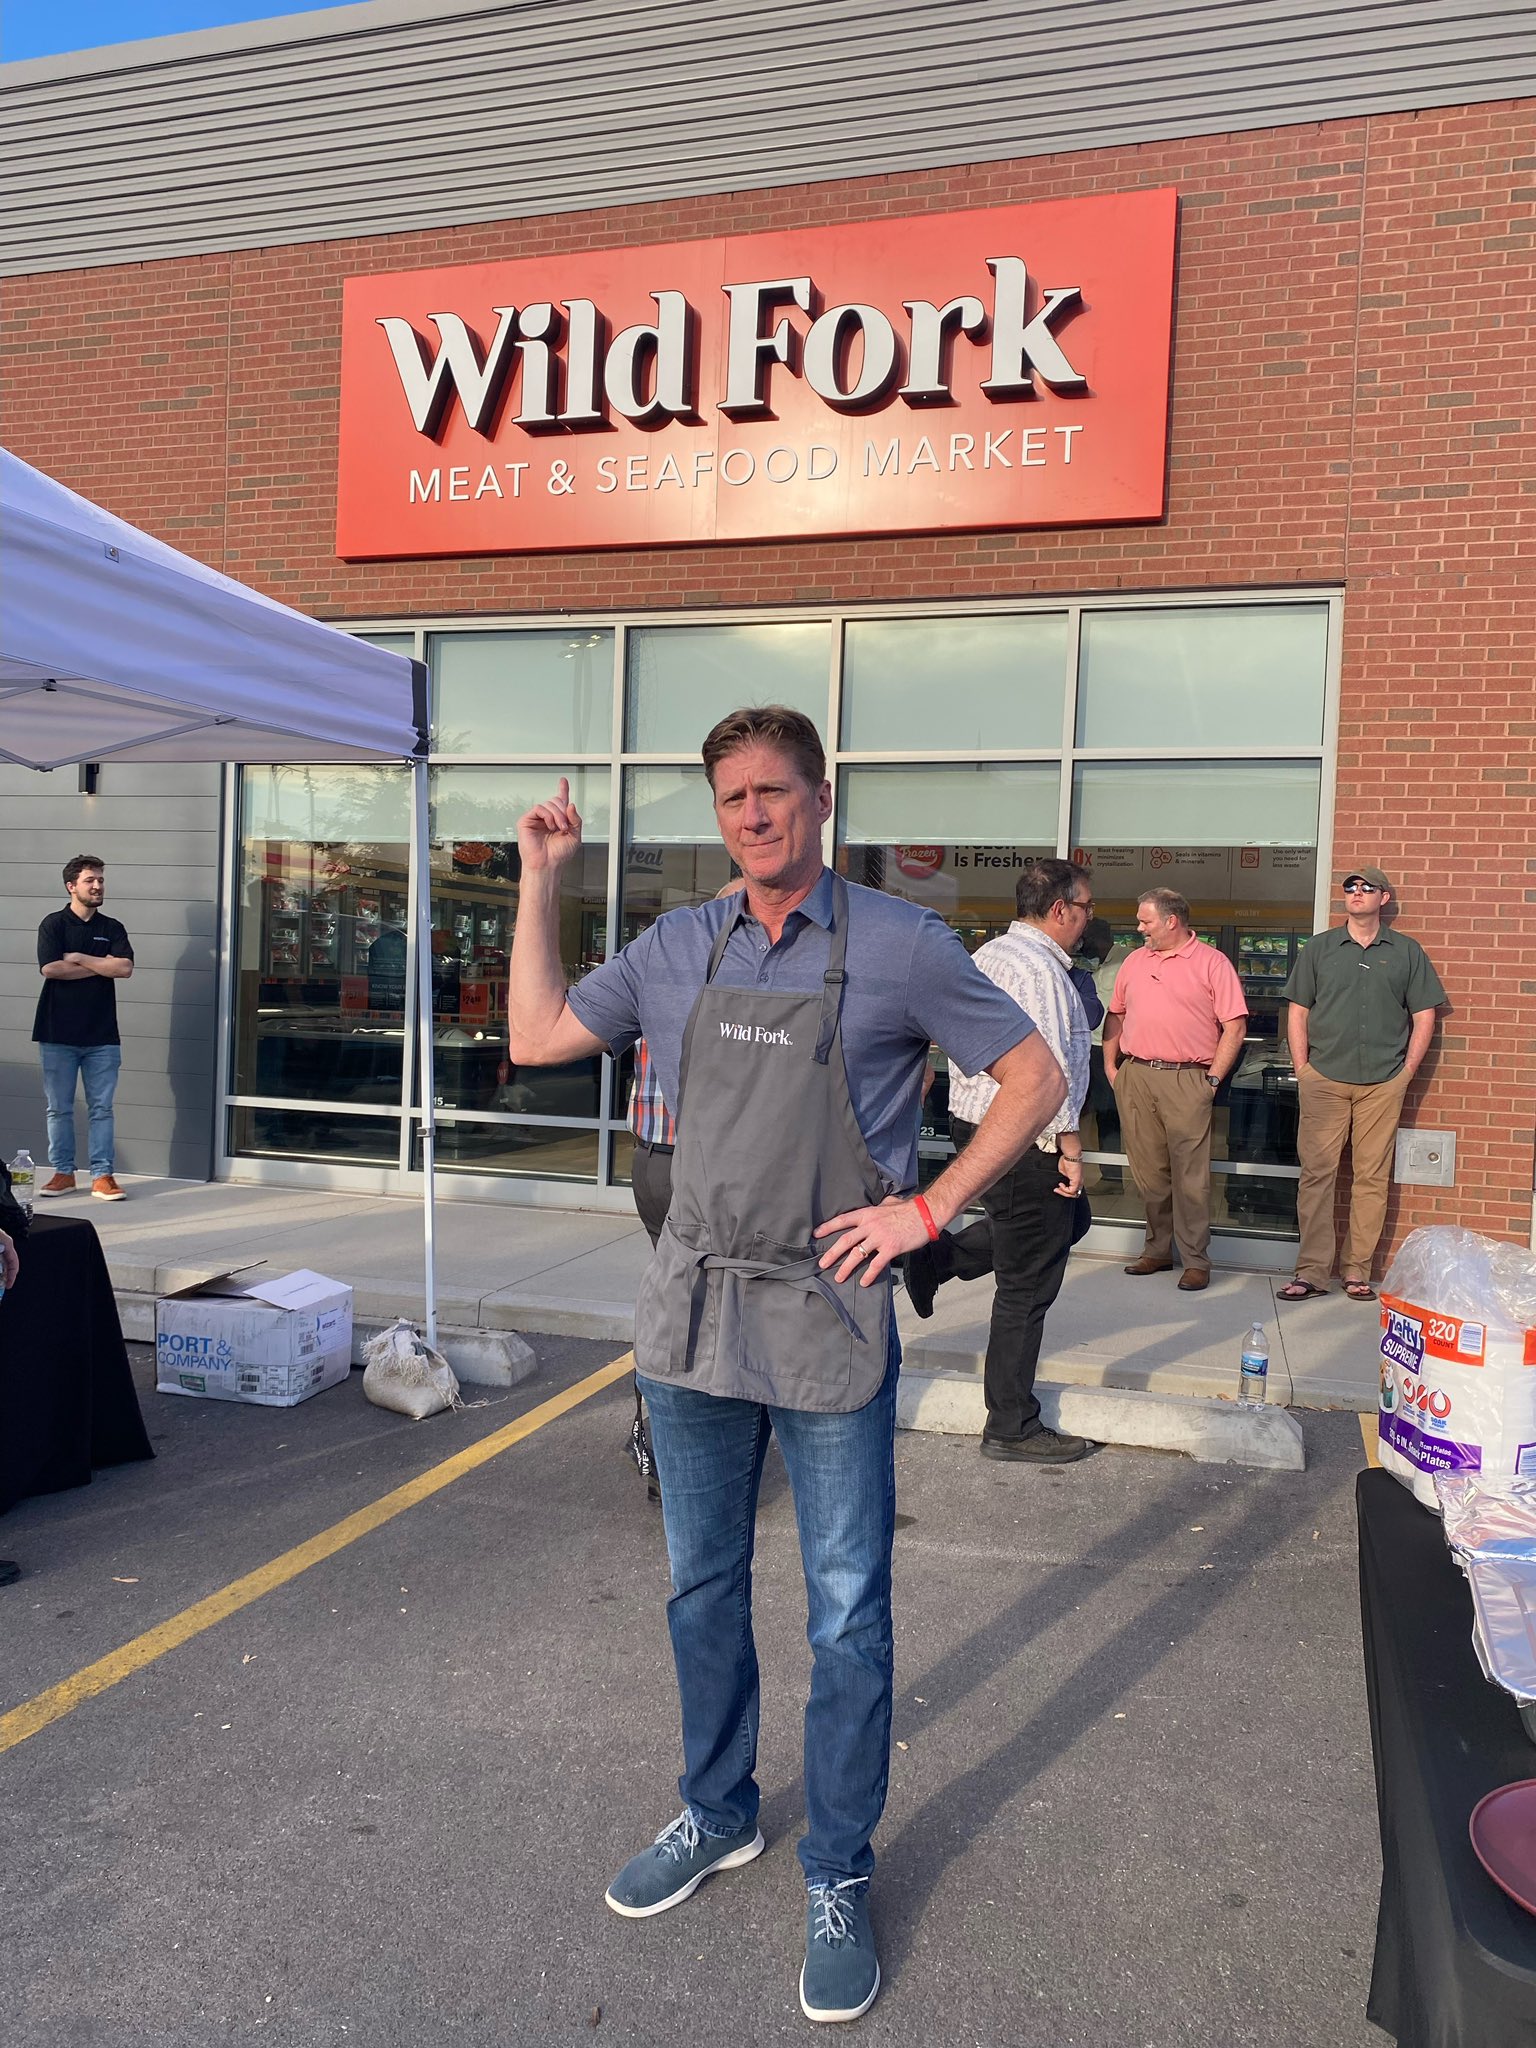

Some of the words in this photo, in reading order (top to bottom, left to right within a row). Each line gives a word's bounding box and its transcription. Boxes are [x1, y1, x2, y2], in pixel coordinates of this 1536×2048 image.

[375, 290, 697, 439] Wild
[717, 255, 1089, 417] Fork
[410, 461, 530, 504] MEAT
[546, 458, 575, 496] &
[596, 442, 839, 494] SEAFOOD
[863, 425, 1085, 477] MARKET
[901, 848, 938, 859] Frozen
[954, 852, 969, 868] Is
[974, 852, 1045, 868] Fresher
[720, 1022, 752, 1042] Wild
[754, 1026, 790, 1046] Fork
[920, 1126, 934, 1136] 23
[1428, 1318, 1456, 1342] 320
[158, 1332, 212, 1354] PORT
[216, 1340, 232, 1356] &
[1433, 1338, 1455, 1348] COUNT
[158, 1351, 232, 1372] COMPANY
[1384, 1338, 1419, 1371] SUPREME
[1420, 1451, 1452, 1470] Plates
[1432, 1445, 1452, 1456] Plates
